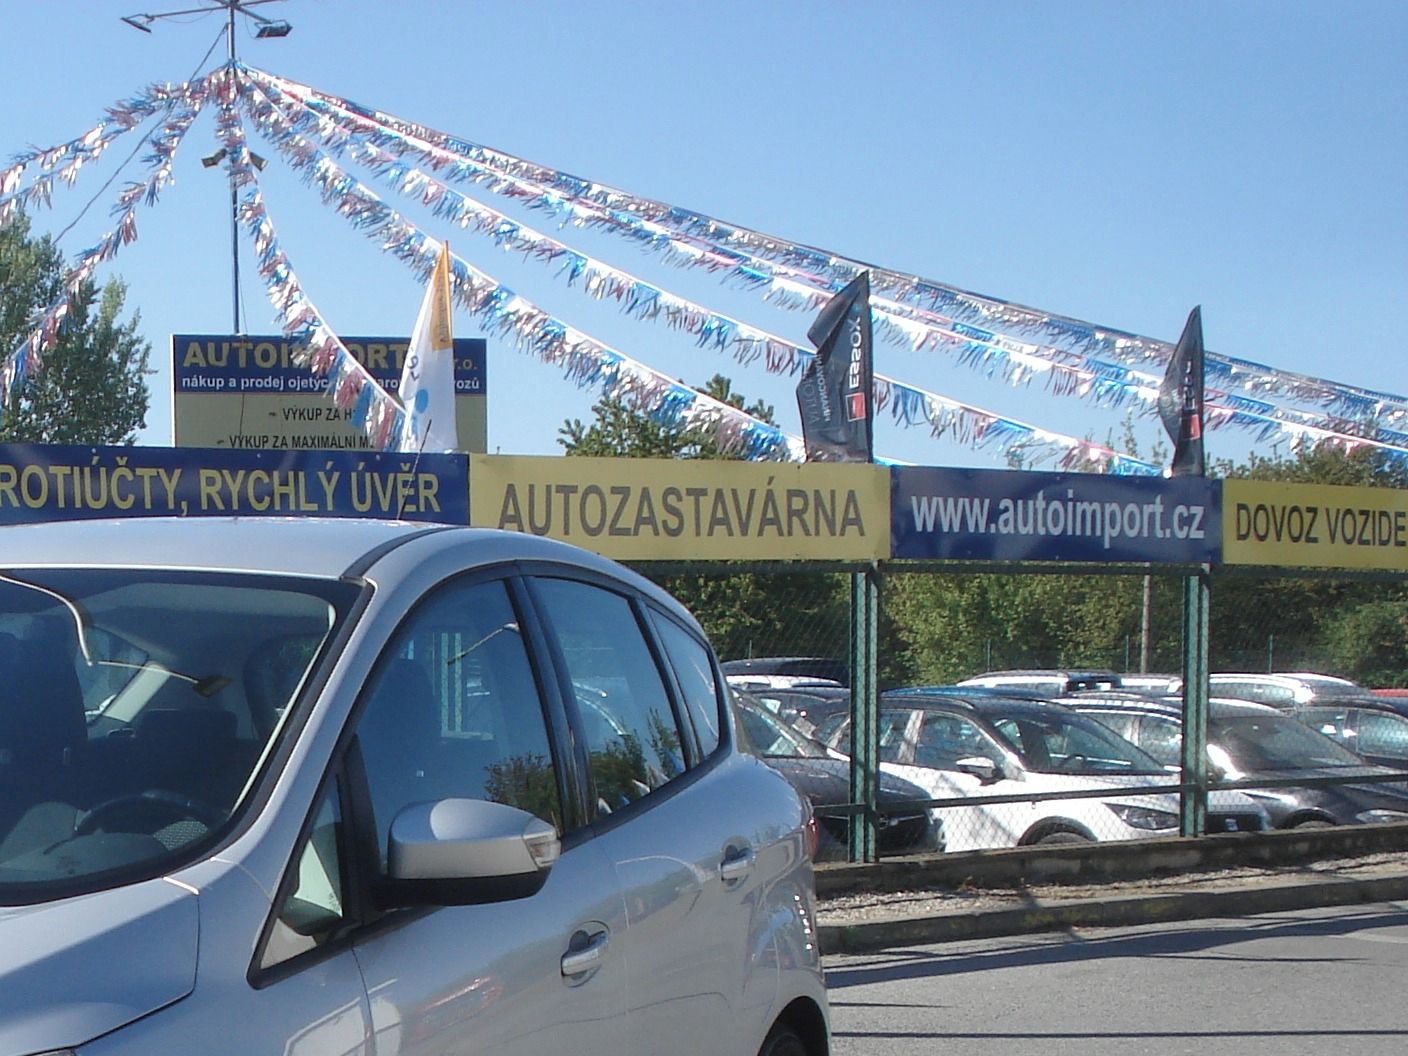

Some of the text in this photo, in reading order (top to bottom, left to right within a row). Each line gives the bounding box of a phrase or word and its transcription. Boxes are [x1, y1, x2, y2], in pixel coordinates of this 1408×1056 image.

[182, 375, 224, 389] nákup
[228, 379, 237, 387] a
[242, 377, 284, 390] prodej
[283, 405, 321, 420] VÝKUP
[326, 408, 340, 420] ZA
[273, 436, 288, 448] ZA
[200, 461, 340, 512] RYCHLÝ
[351, 462, 441, 513] ÚVĚR
[499, 476, 865, 537] AUTOZASTAVÁRNA
[911, 489, 1205, 549] www.autoimport.cz
[1236, 502, 1319, 544] DOVOZ
